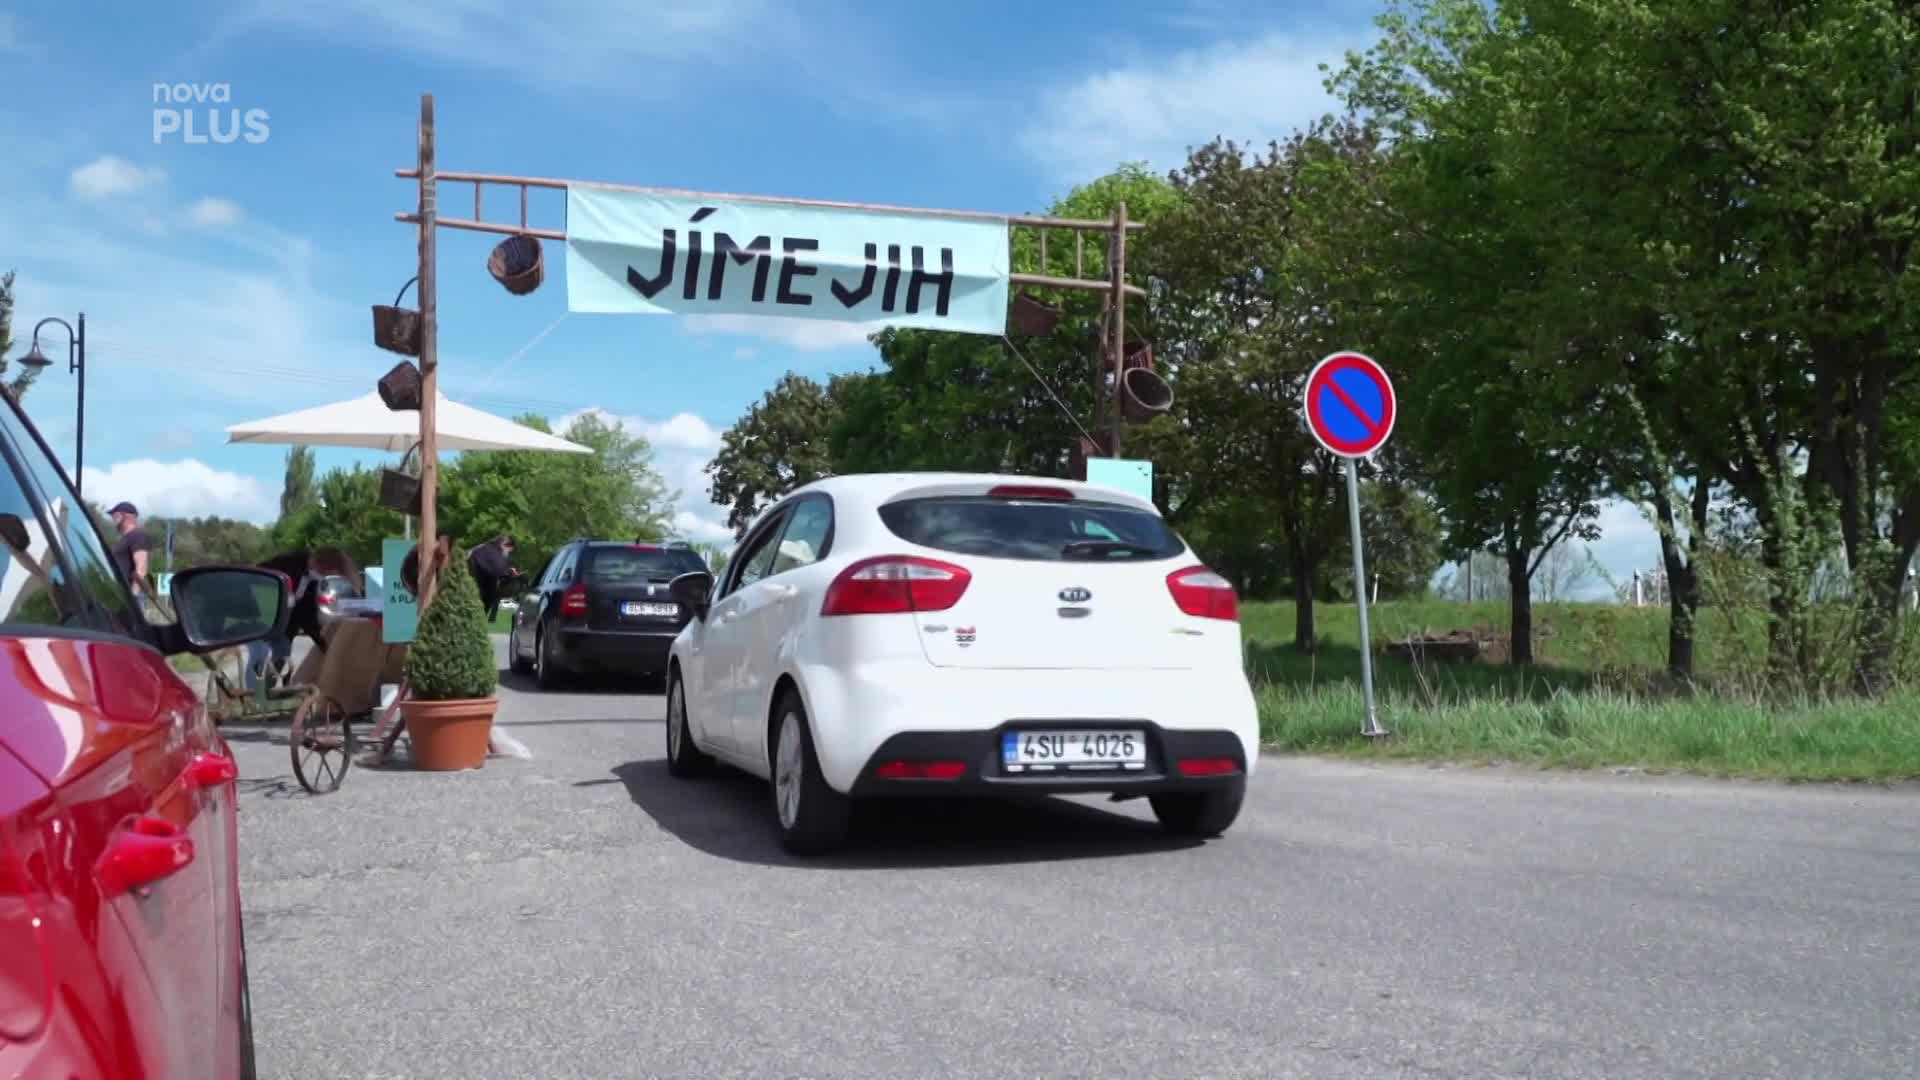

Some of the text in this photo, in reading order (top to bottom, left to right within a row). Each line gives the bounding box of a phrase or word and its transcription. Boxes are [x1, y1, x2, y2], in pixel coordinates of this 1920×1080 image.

[627, 206, 954, 317] JÍME JIH
[1023, 735, 1065, 758] 4SU
[1081, 735, 1135, 758] 4026
